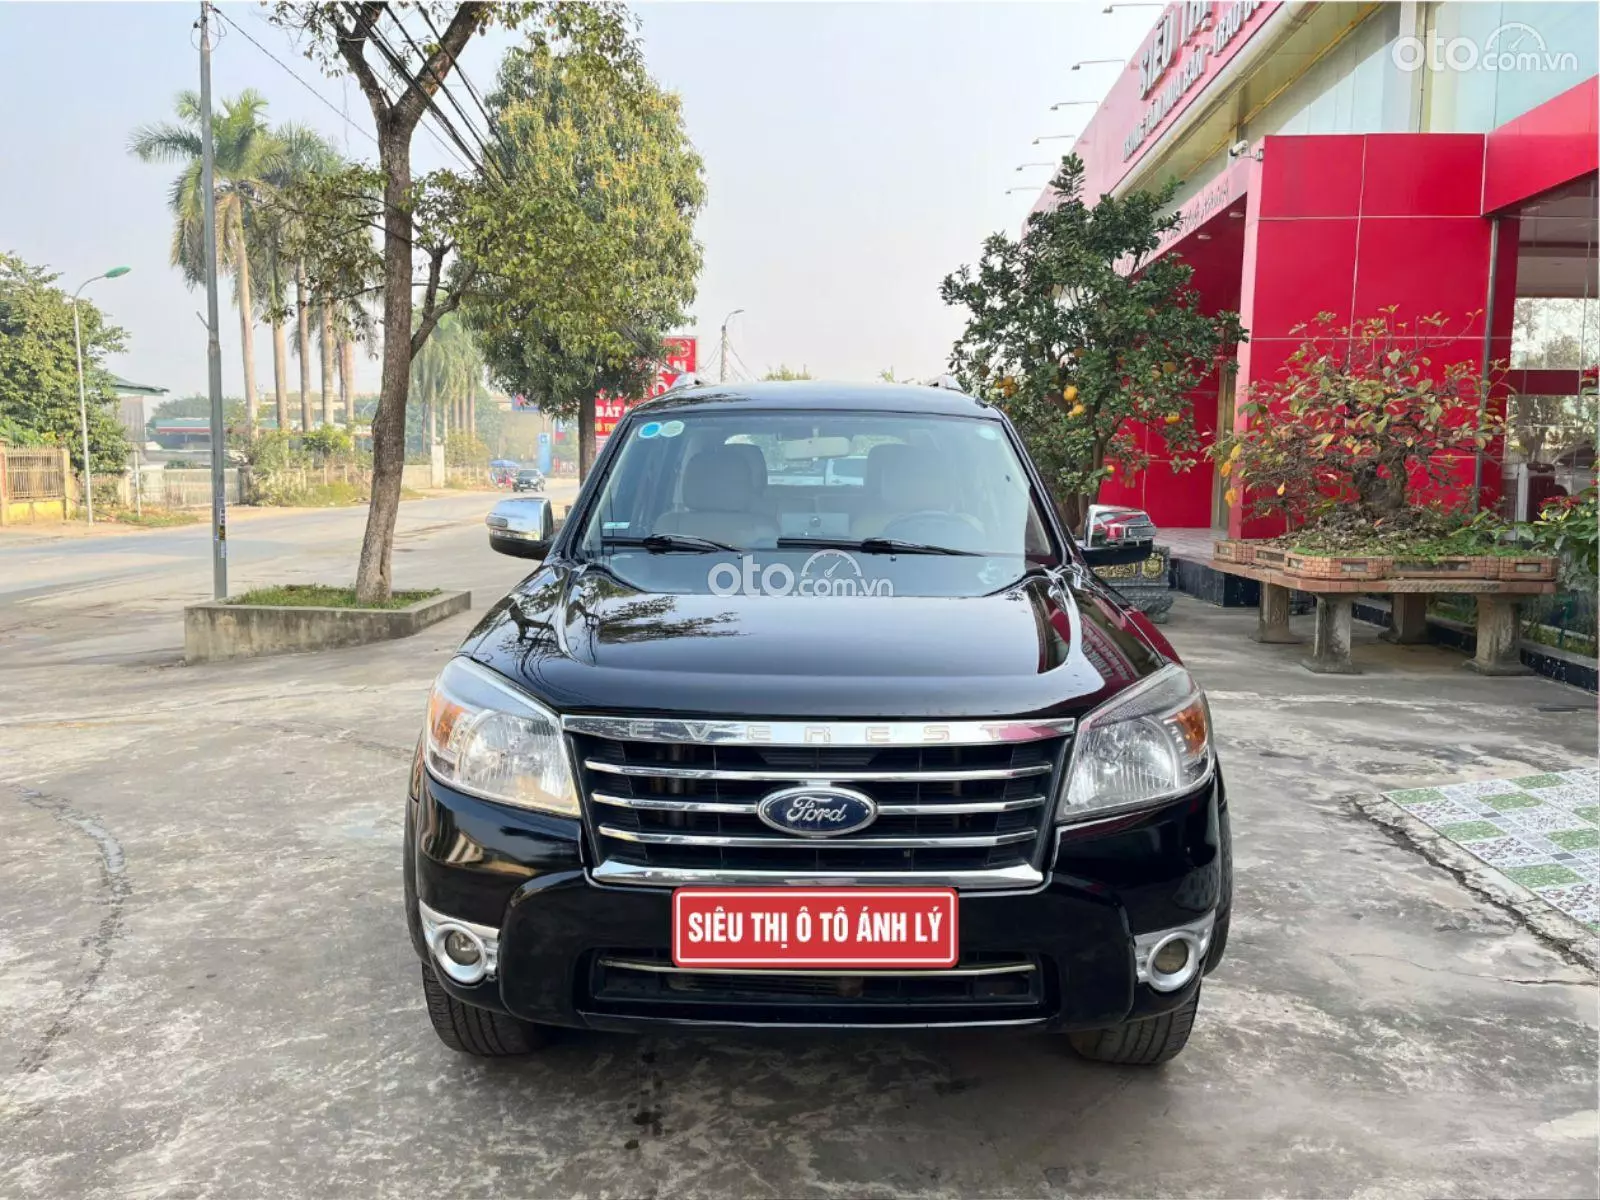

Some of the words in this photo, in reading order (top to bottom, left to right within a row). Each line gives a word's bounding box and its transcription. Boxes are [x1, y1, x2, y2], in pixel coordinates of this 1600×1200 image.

[629, 722, 1010, 743] EVEREST
[787, 796, 847, 822] Ford
[688, 906, 743, 943] SIÊU
[751, 912, 788, 949] THỊ
[796, 906, 812, 943] Ô
[819, 906, 849, 943] TÔ
[856, 906, 907, 942] ÁNH
[915, 906, 942, 942] LÝ
